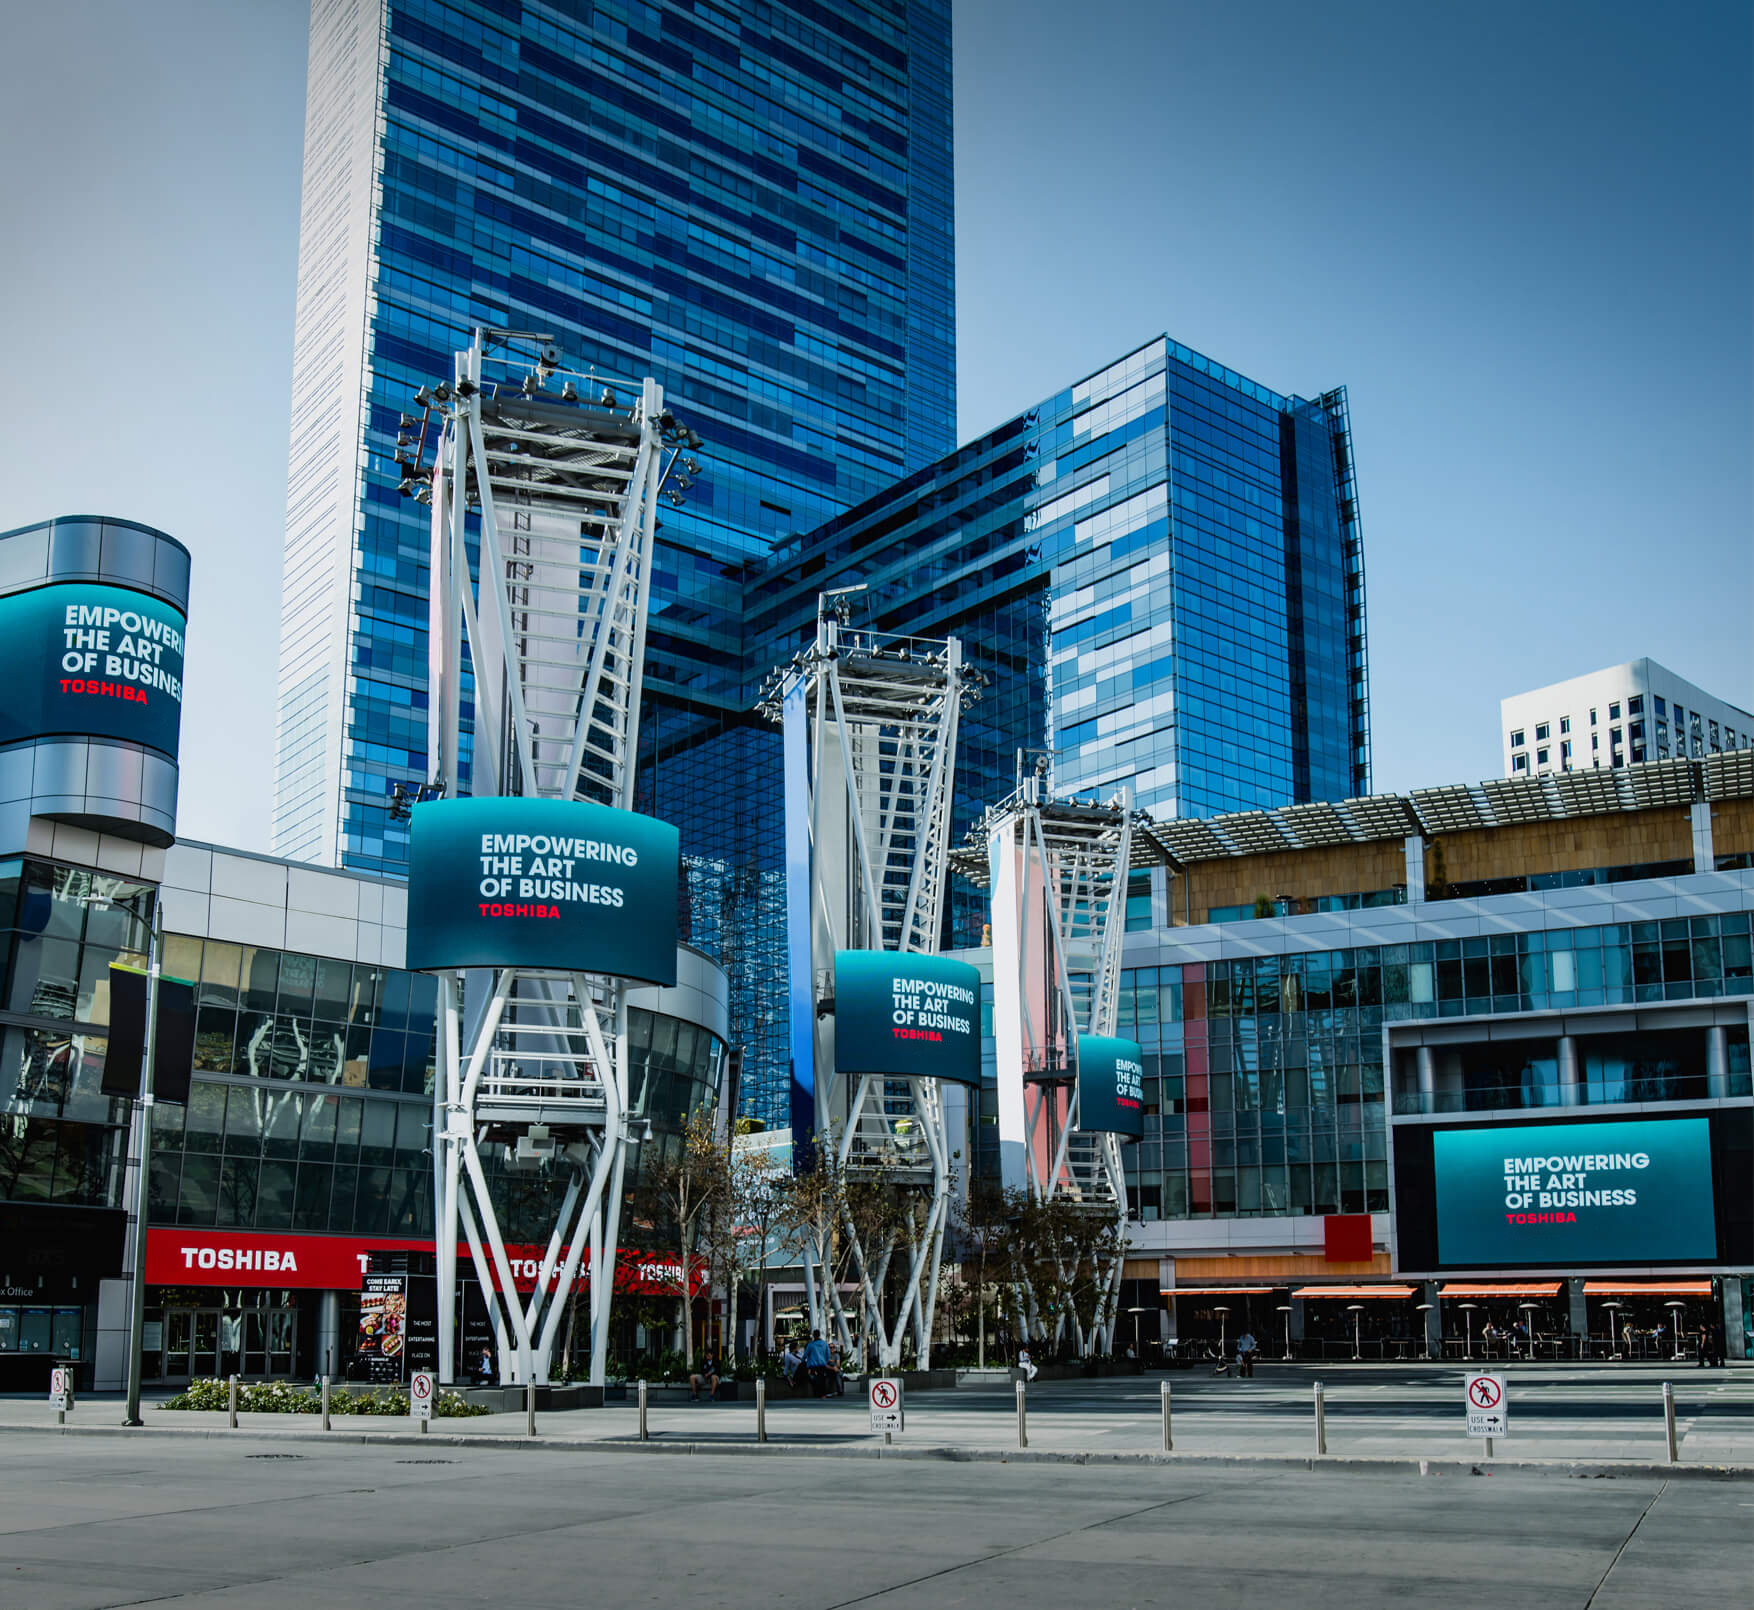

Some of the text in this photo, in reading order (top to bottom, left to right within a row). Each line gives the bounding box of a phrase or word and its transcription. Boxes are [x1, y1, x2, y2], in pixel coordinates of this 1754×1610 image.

[64, 628, 163, 665] THE ART
[61, 652, 97, 673] OF
[59, 679, 148, 705] TOSHIBA
[481, 834, 638, 867] EMPOWERING
[480, 856, 575, 879] THE ART
[479, 878, 624, 908] OF BUSINESS
[478, 903, 560, 919] TOSHIBA
[892, 978, 974, 1005] EMPOWERING
[892, 993, 949, 1014] THE ART
[892, 1010, 970, 1035] OF BUSINESS
[891, 1028, 943, 1042] TOSHIBA
[1115, 1071, 1131, 1085] THE
[1116, 1084, 1129, 1096] OF
[1503, 1152, 1650, 1174] EMPOWERING
[1503, 1173, 1587, 1192] THE ART
[1504, 1189, 1637, 1209] OF BUSINESS
[1505, 1212, 1577, 1225] TOSHIBA
[181, 1247, 298, 1272] TOSHIBA
[7, 1287, 34, 1297] Office
[1471, 1416, 1485, 1424] USE
